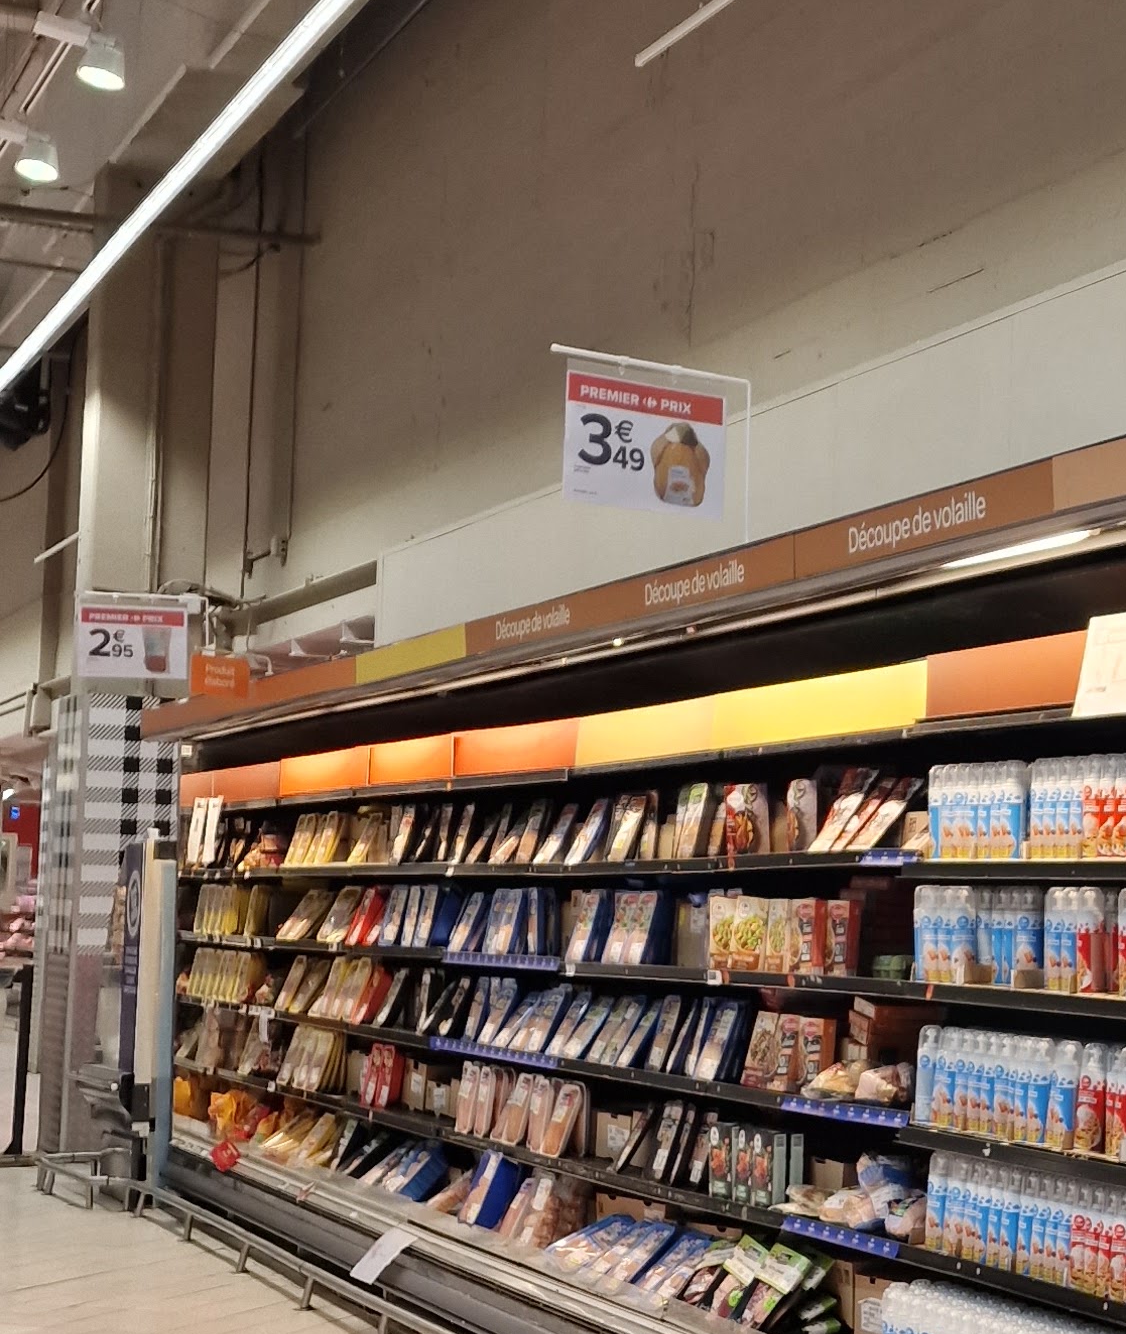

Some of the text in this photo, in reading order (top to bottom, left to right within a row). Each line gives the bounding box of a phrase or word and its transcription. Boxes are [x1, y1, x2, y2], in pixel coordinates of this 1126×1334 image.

[580, 384, 692, 414] PREMIER PRIX
[848, 491, 986, 554] Découpe de volaille
[644, 559, 745, 605] Découpe de volaille
[89, 613, 129, 621] PREMIER
[495, 604, 571, 640] Découpe de volaille
